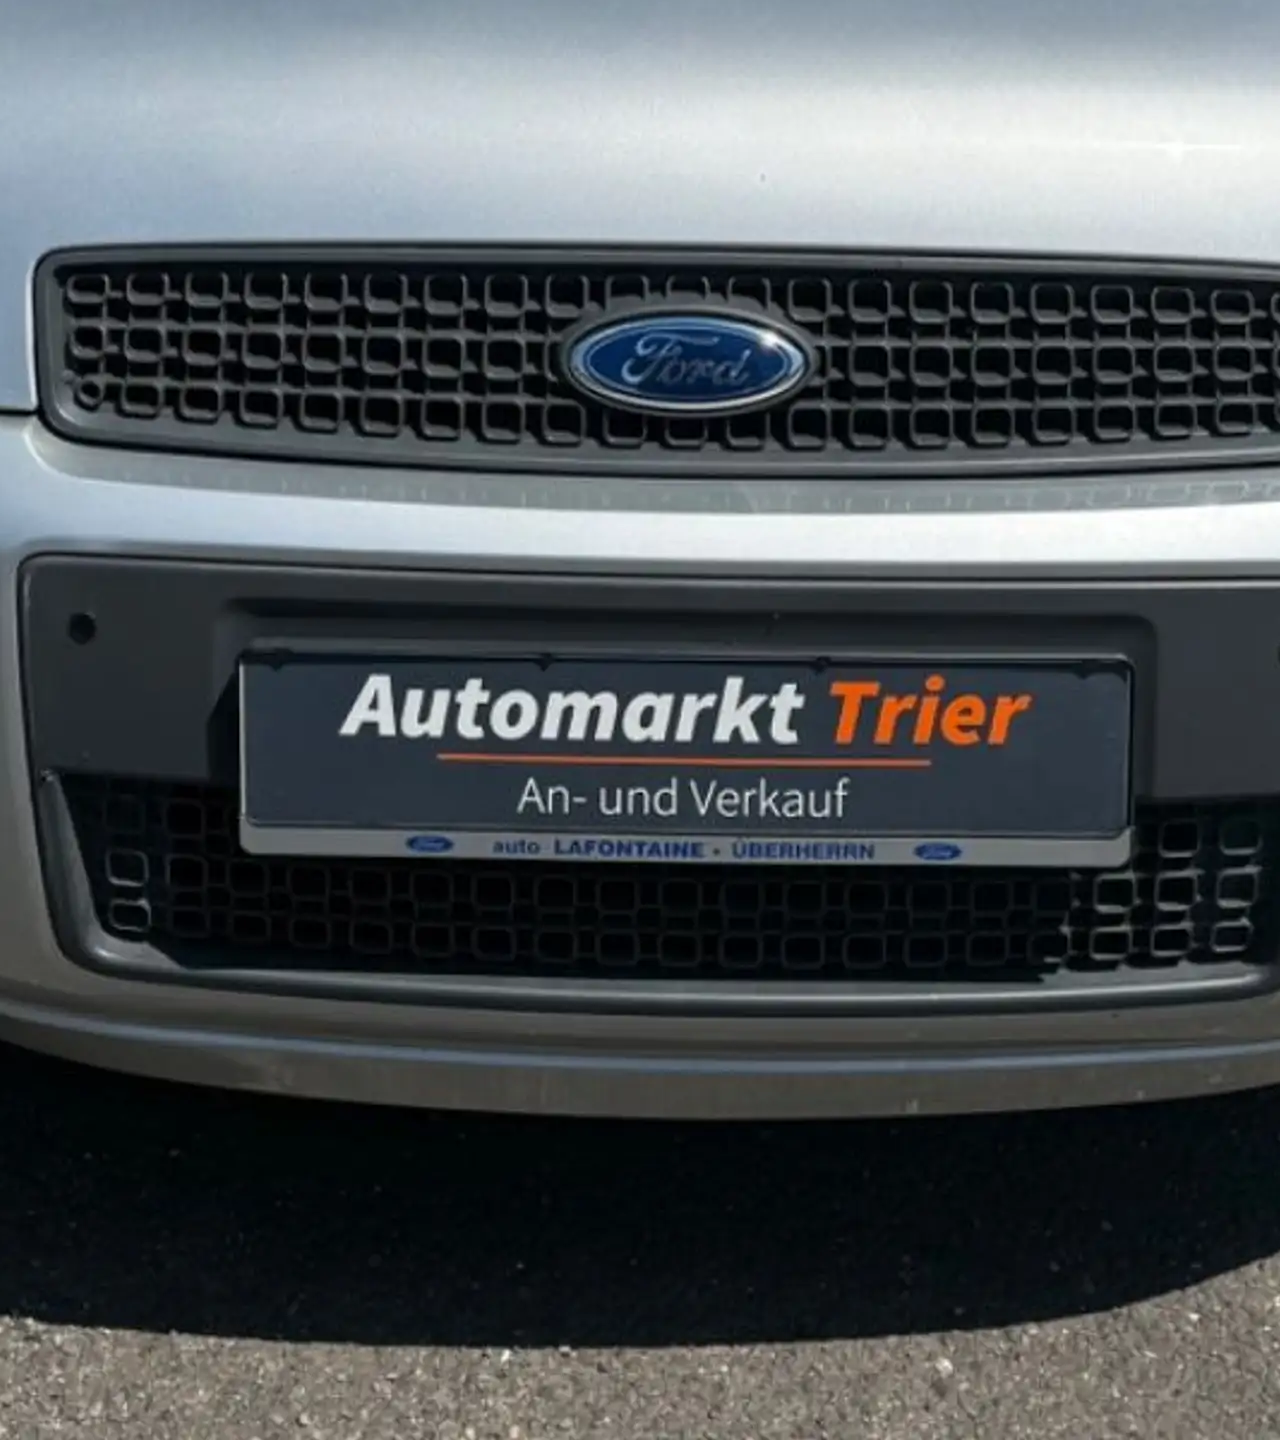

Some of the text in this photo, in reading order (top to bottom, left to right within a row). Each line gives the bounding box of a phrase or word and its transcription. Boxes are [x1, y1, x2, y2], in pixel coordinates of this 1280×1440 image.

[621, 332, 751, 388] Ford
[338, 673, 1033, 745] Automarkt Trier
[516, 776, 852, 818] An- und Verkauf
[493, 837, 541, 856] auto
[553, 838, 704, 859] LAFONTAINE
